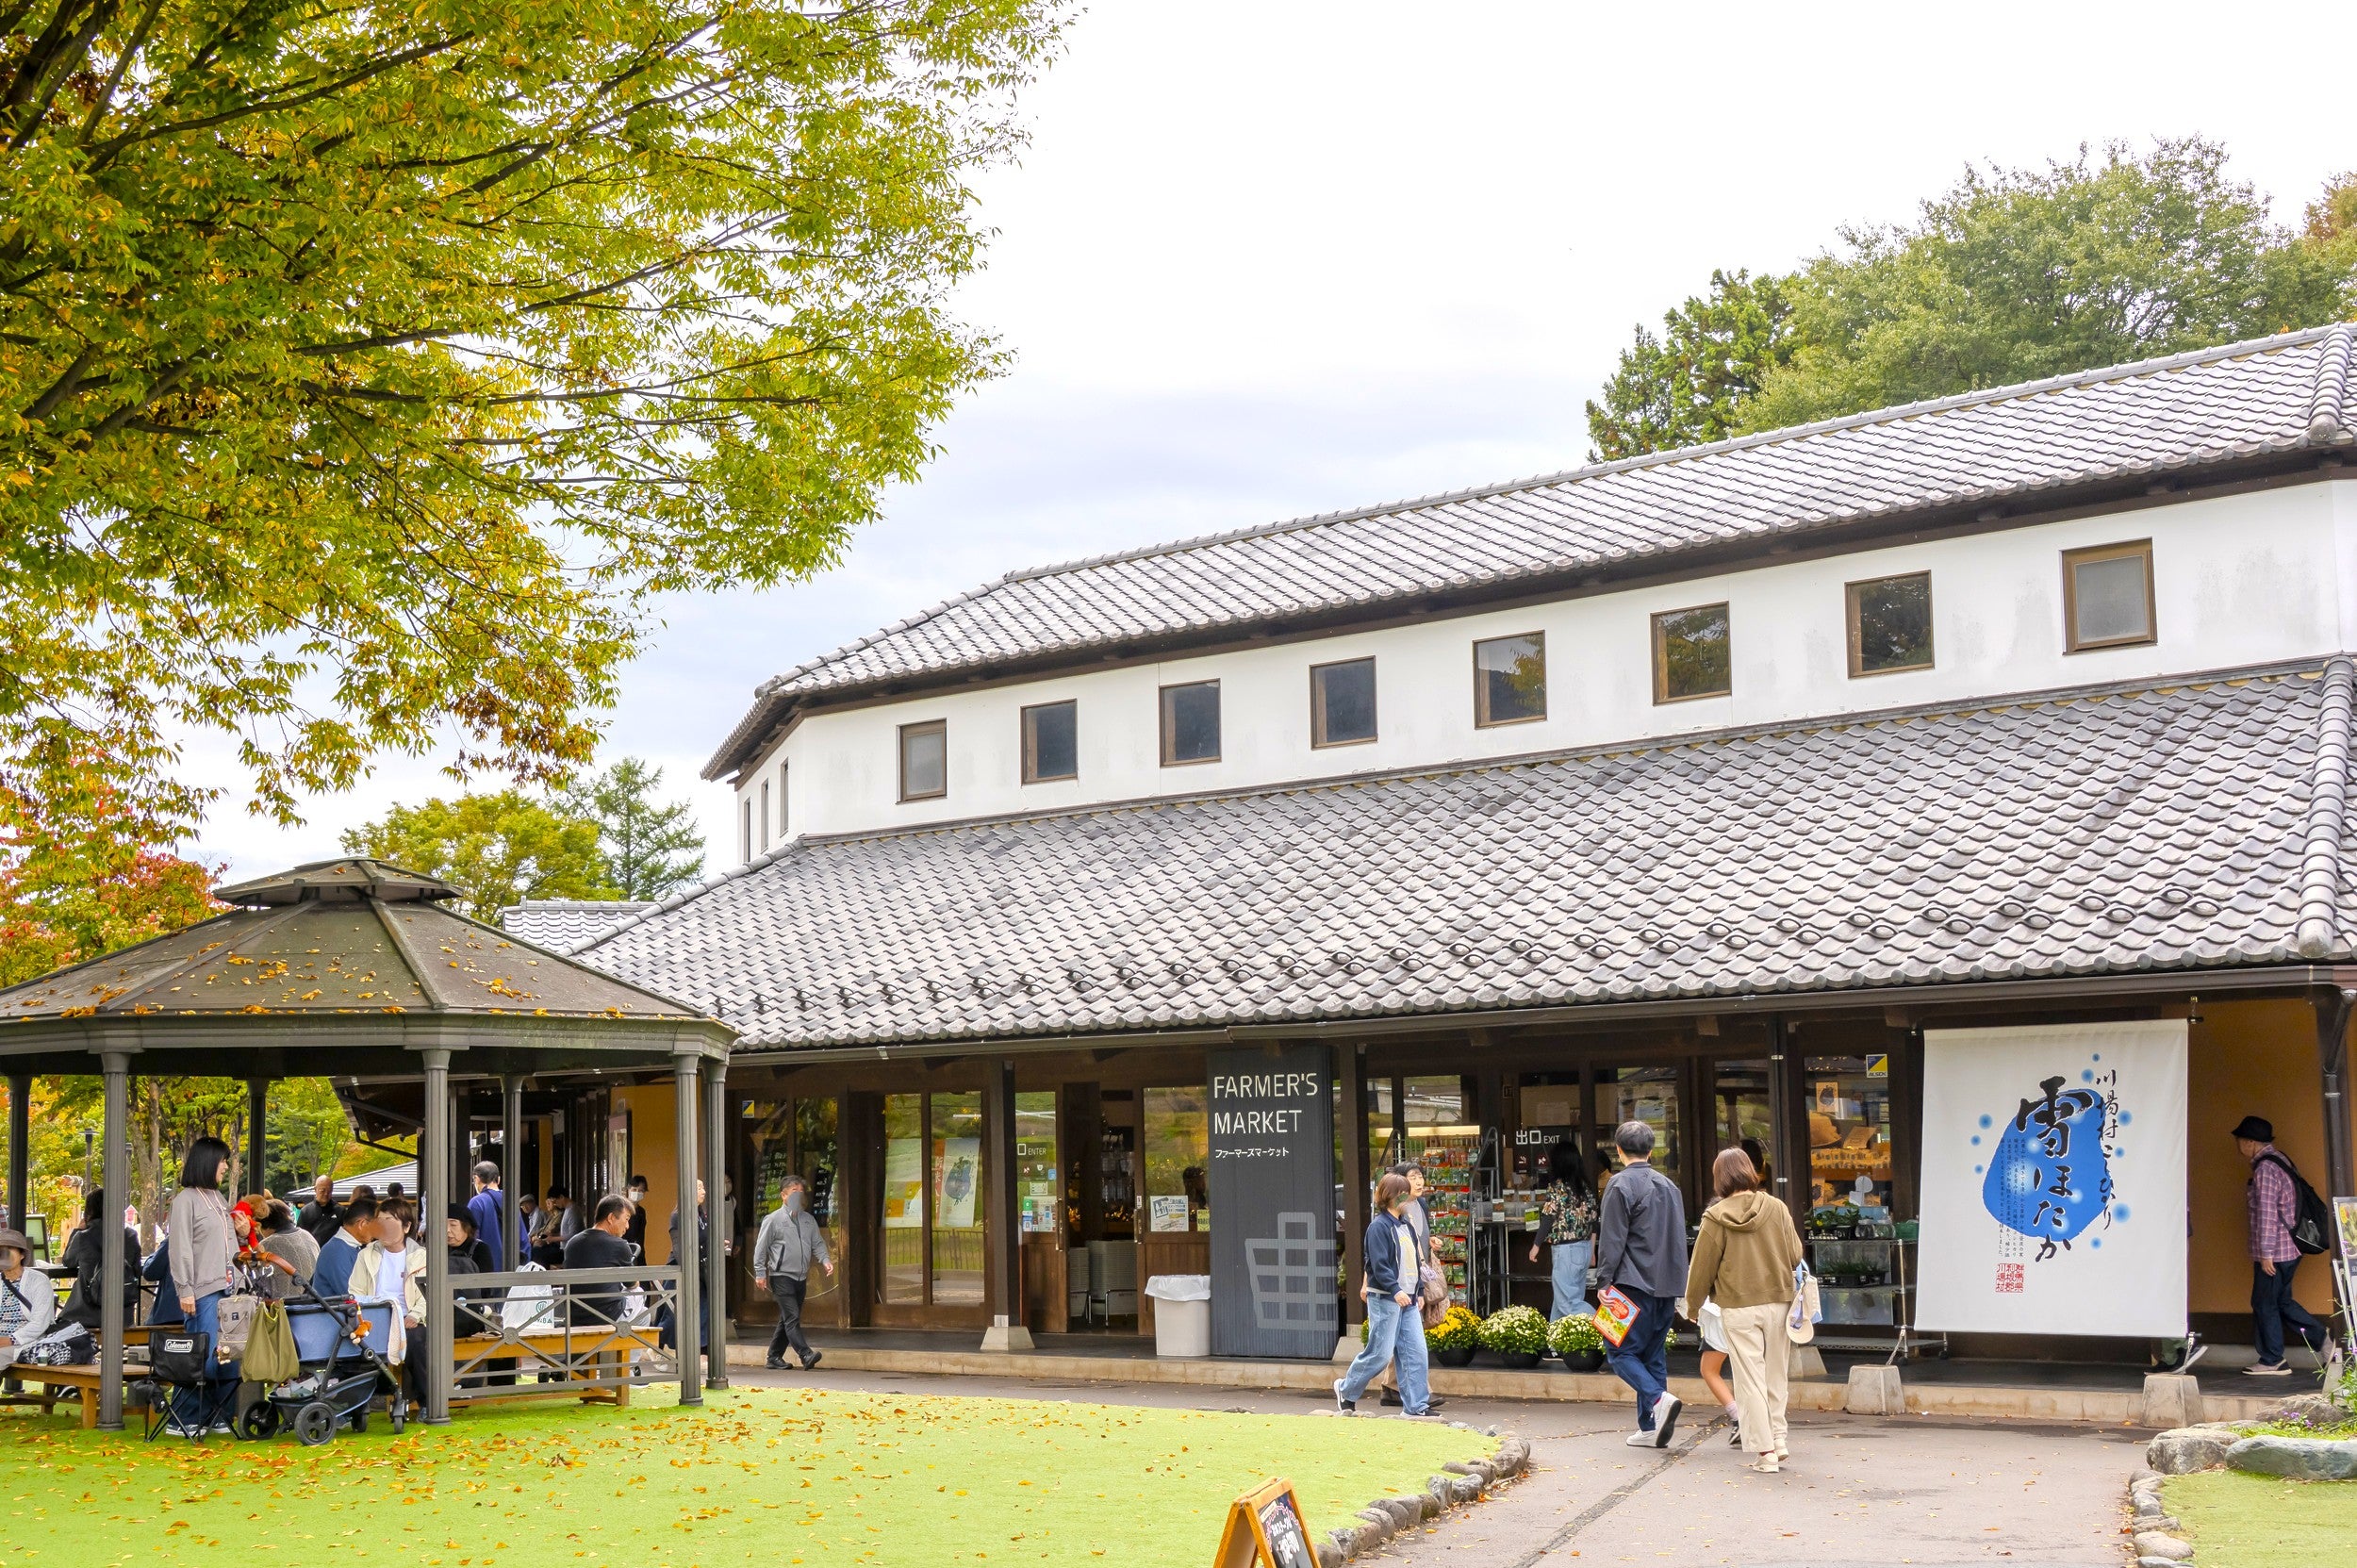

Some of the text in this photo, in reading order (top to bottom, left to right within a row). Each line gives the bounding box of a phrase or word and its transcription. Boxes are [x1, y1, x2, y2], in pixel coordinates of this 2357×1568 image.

[1213, 1072, 1318, 1098] FARMER'S
[1214, 1110, 1303, 1134] MARKET
[1515, 1130, 1560, 1145] 出口 EXIT
[2096, 1069, 2119, 1230] 川場村こしひかり
[1028, 1147, 1047, 1156] ENTER
[1215, 1147, 1290, 1159] ファーマーズマーケット
[2016, 1075, 2094, 1263] 雪ほたか
